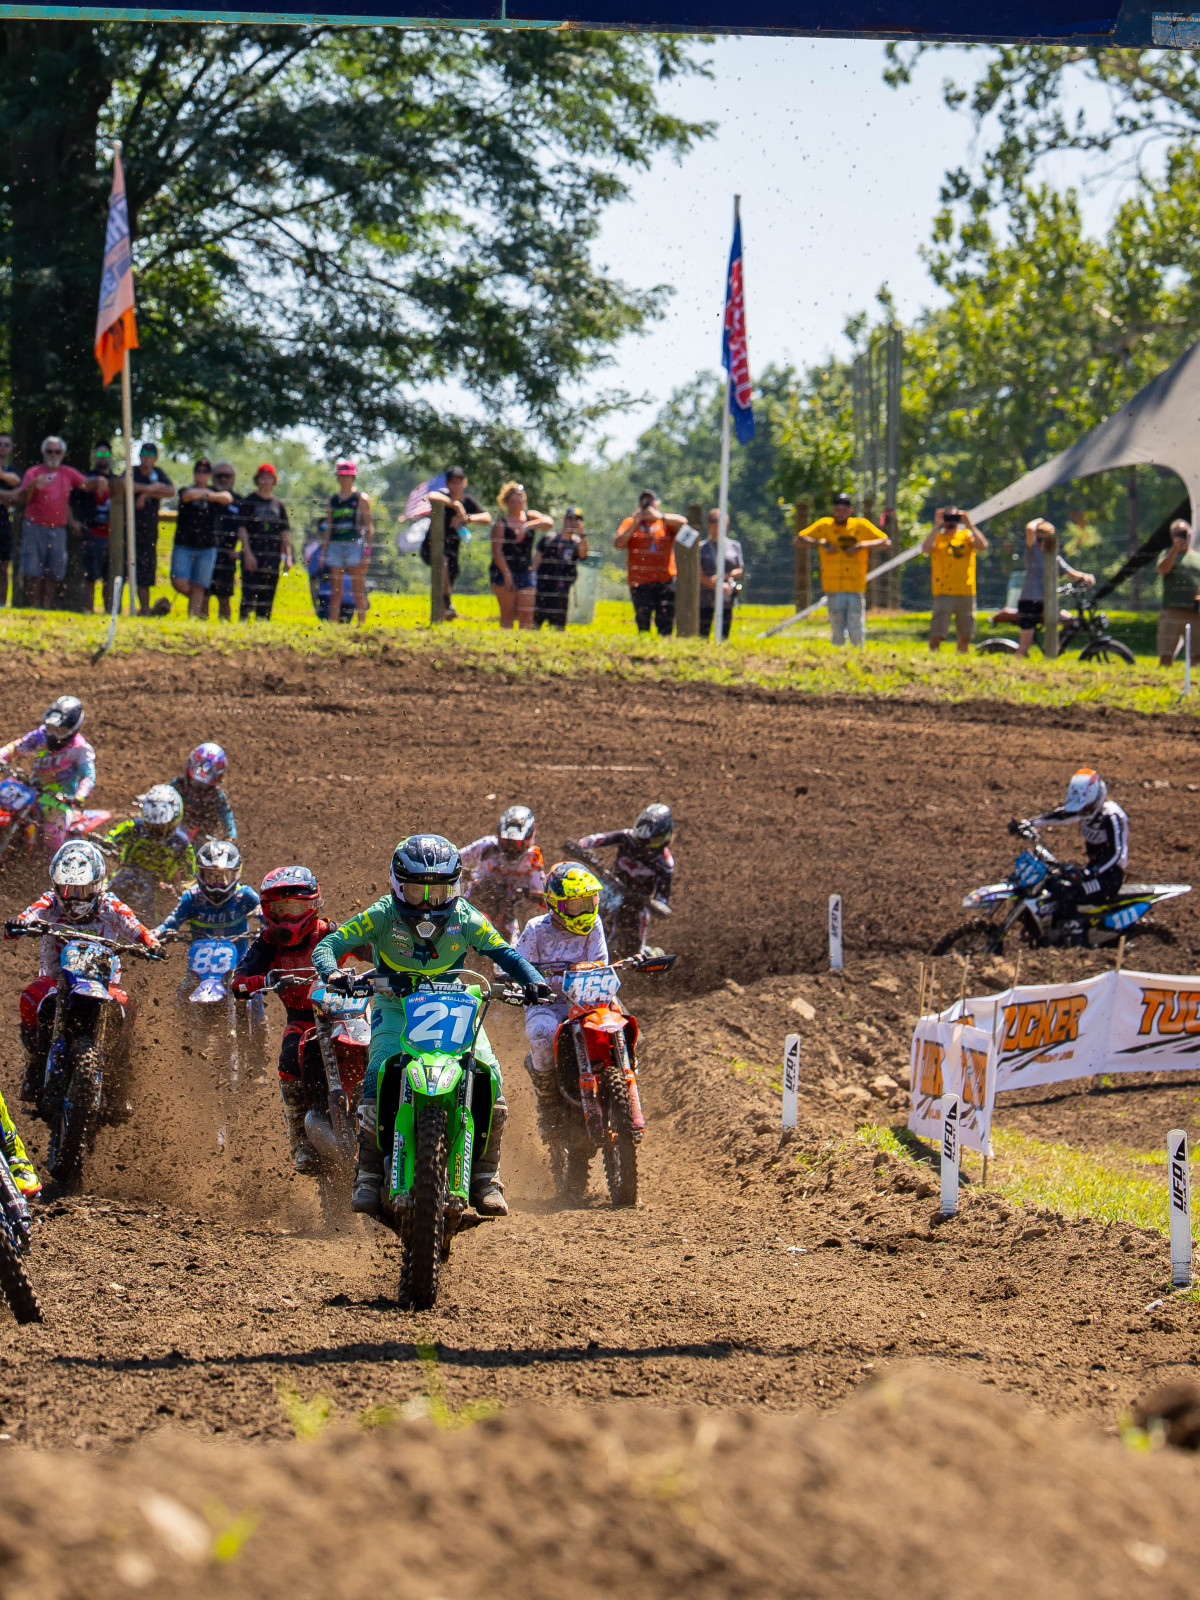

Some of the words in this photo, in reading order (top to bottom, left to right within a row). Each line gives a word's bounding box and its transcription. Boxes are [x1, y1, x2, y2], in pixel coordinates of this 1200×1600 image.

[1112, 907, 1138, 930] 111
[193, 947, 234, 974] 83
[504, 997, 523, 1005] ASV
[408, 1001, 474, 1044] 21
[1001, 994, 1088, 1051] UCKER
[785, 1057, 794, 1091] UFO
[391, 1130, 400, 1190] DUNLOP
[462, 1129, 473, 1193] DUNLOP
[944, 1120, 953, 1161] UFO
[1172, 1161, 1184, 1212] UFO
